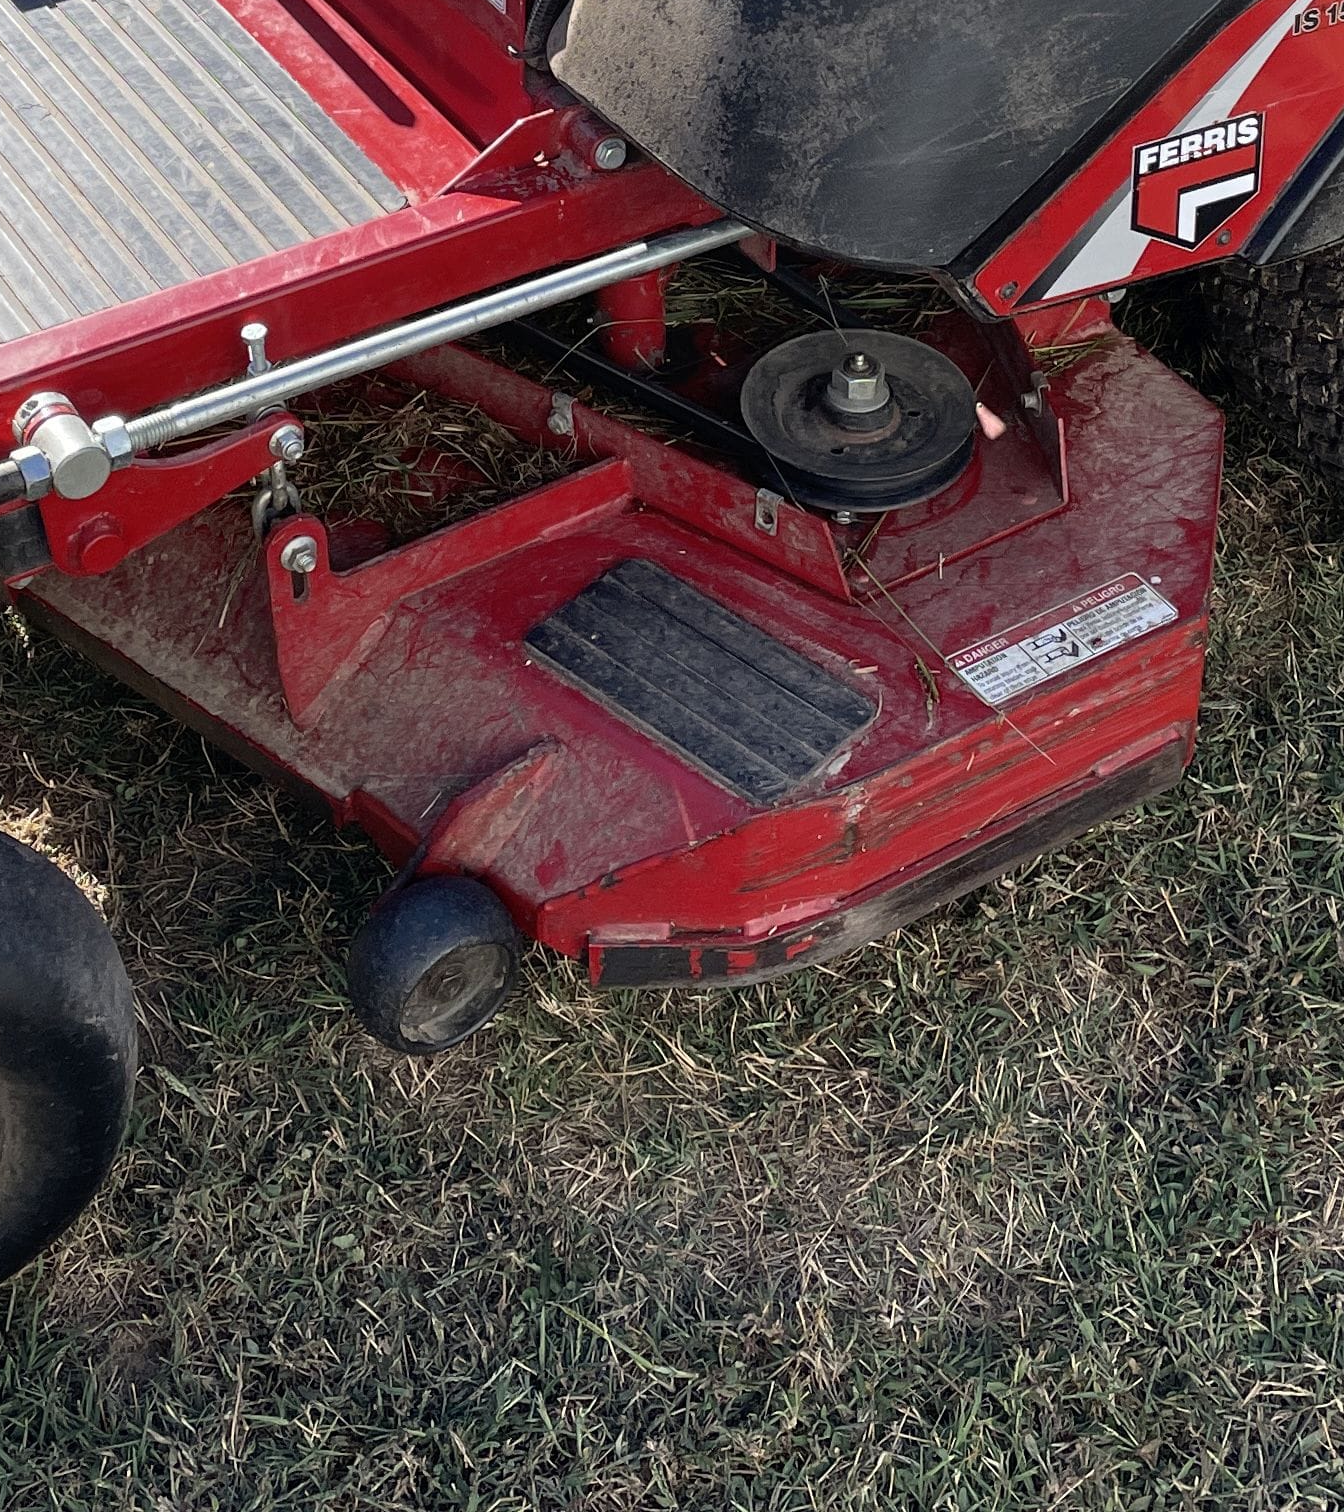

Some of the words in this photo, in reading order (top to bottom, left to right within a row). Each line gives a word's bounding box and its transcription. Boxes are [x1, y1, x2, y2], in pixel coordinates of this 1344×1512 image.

[1292, 7, 1321, 36] IS
[1138, 117, 1259, 175] FERRIS
[1080, 583, 1126, 609] PELIGRO
[962, 637, 1010, 664] DANGER
